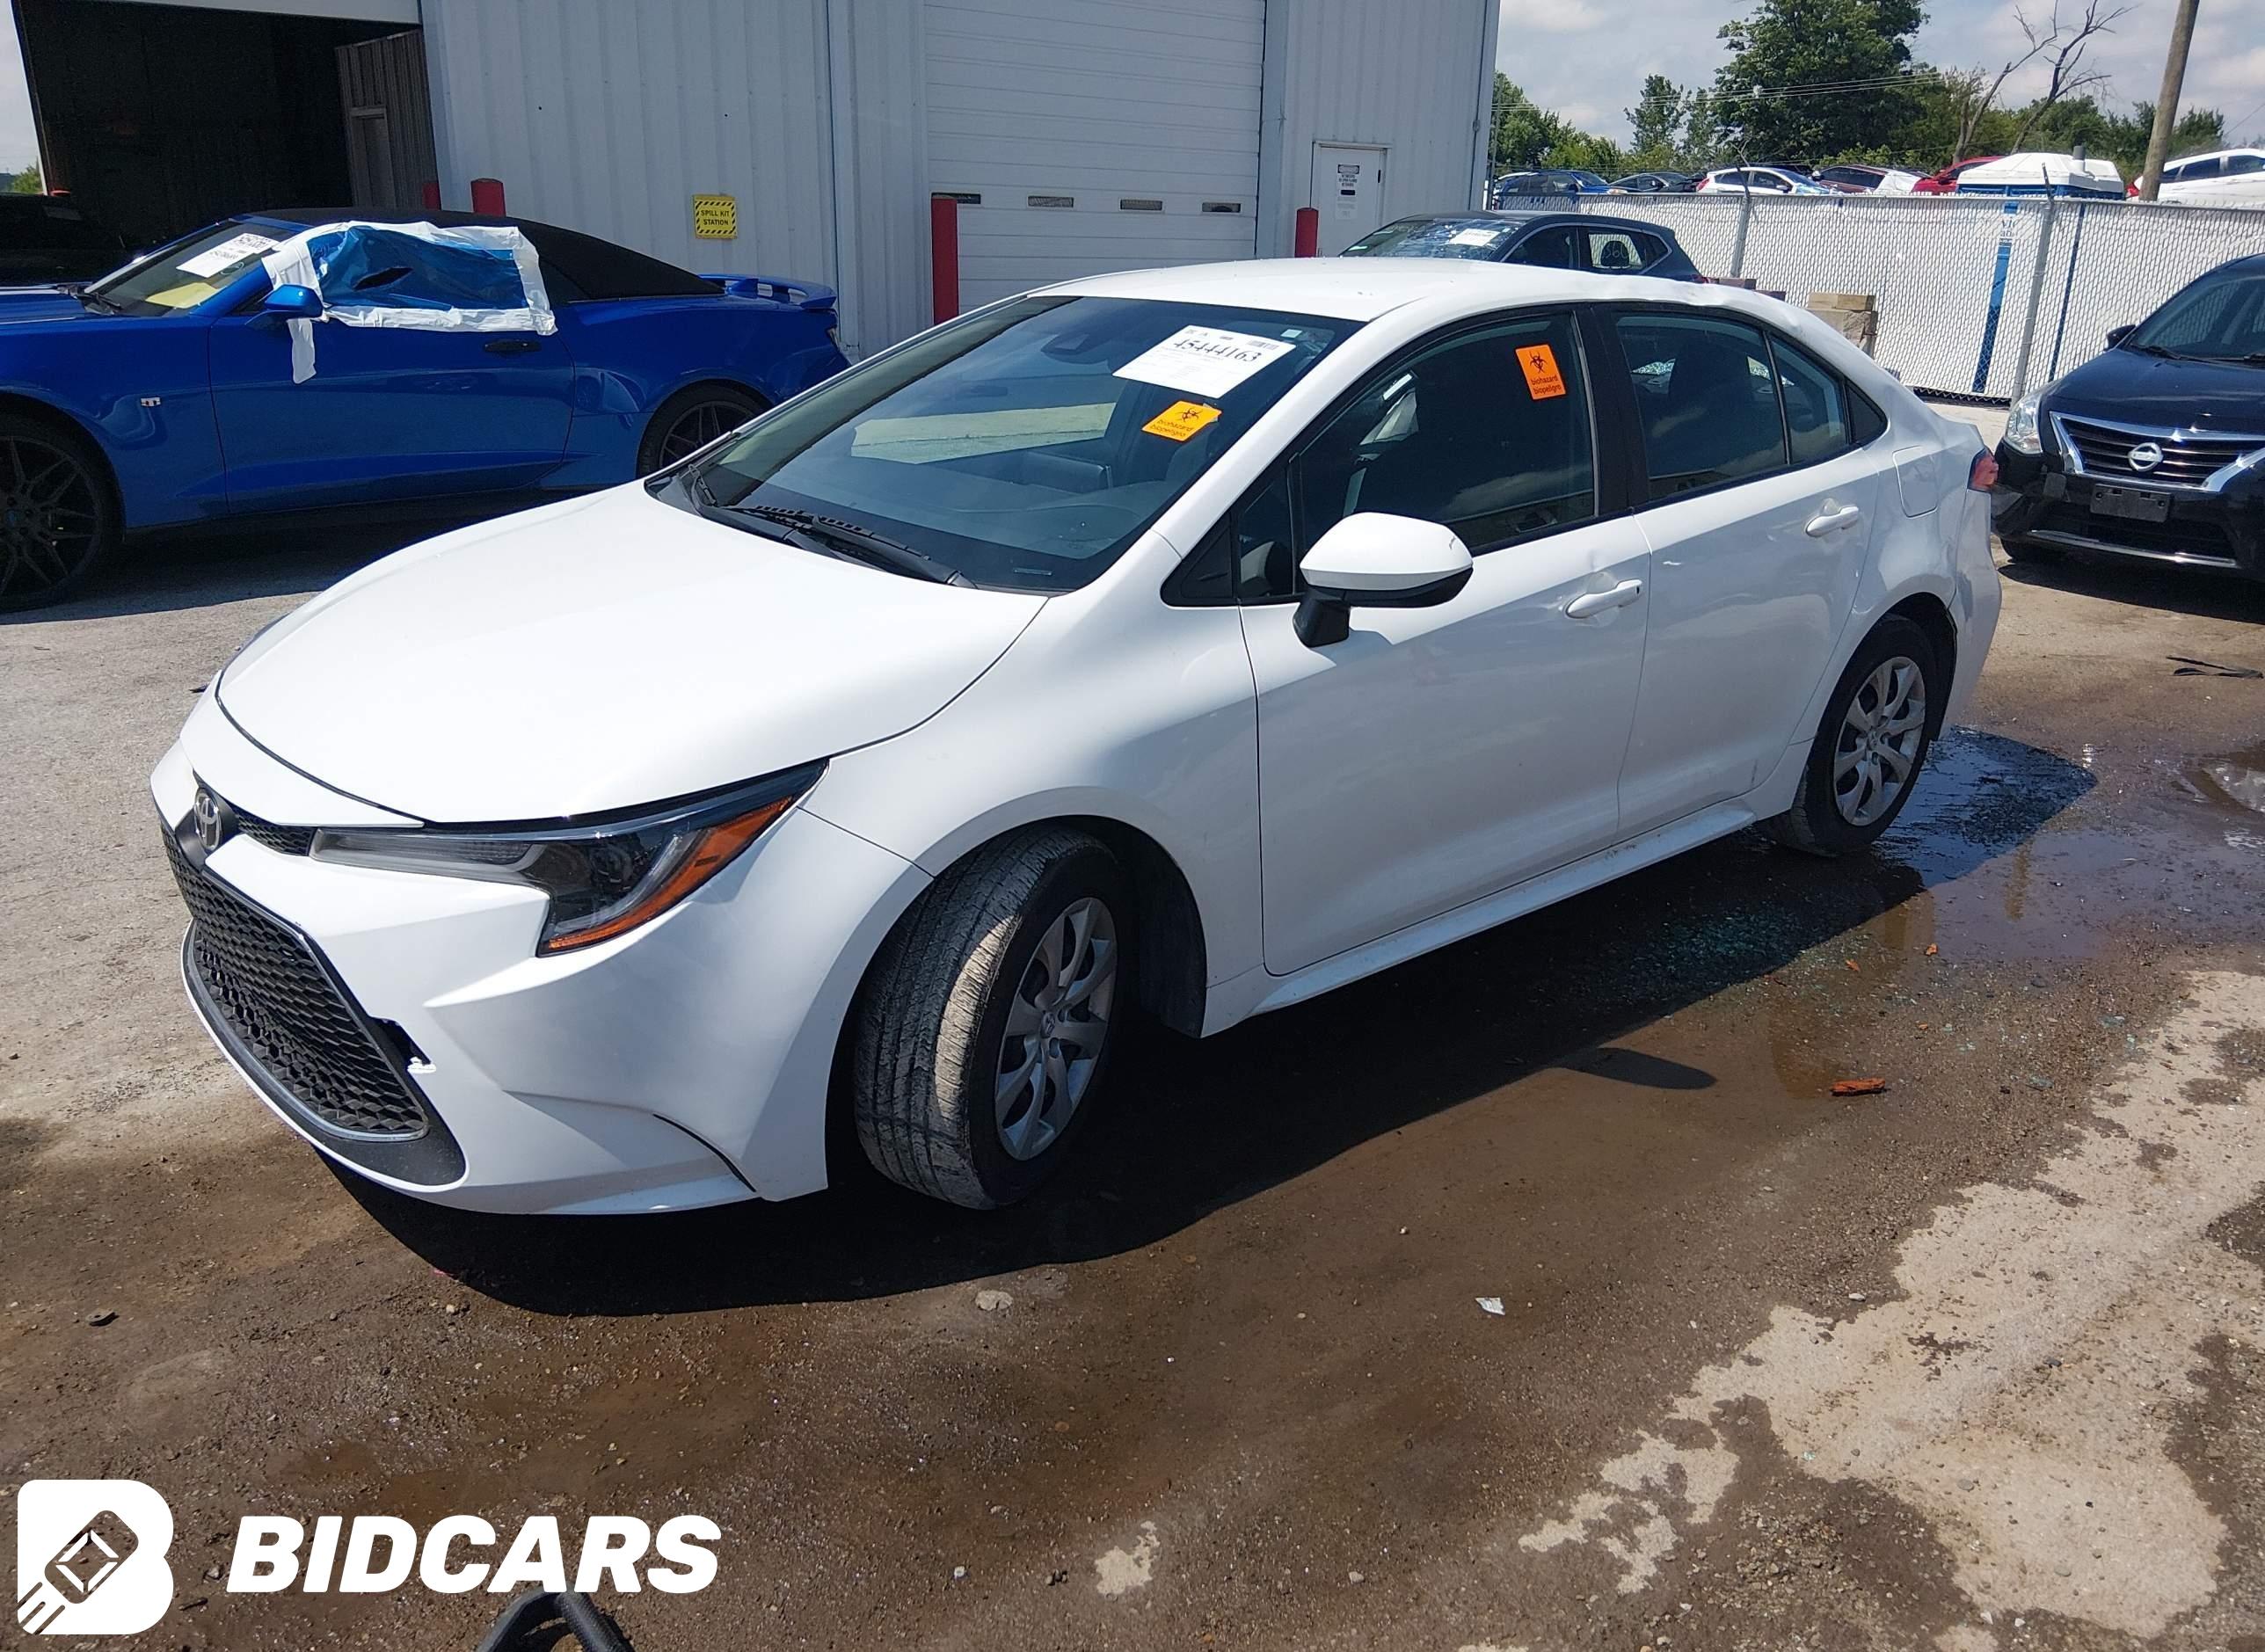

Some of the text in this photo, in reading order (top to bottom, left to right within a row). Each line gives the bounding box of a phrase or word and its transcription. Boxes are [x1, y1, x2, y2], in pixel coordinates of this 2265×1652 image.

[1173, 338, 1263, 362] 45444163
[1531, 375, 1559, 386] biohazard
[1533, 383, 1562, 395] biopeligro
[1156, 418, 1195, 432] biohazard
